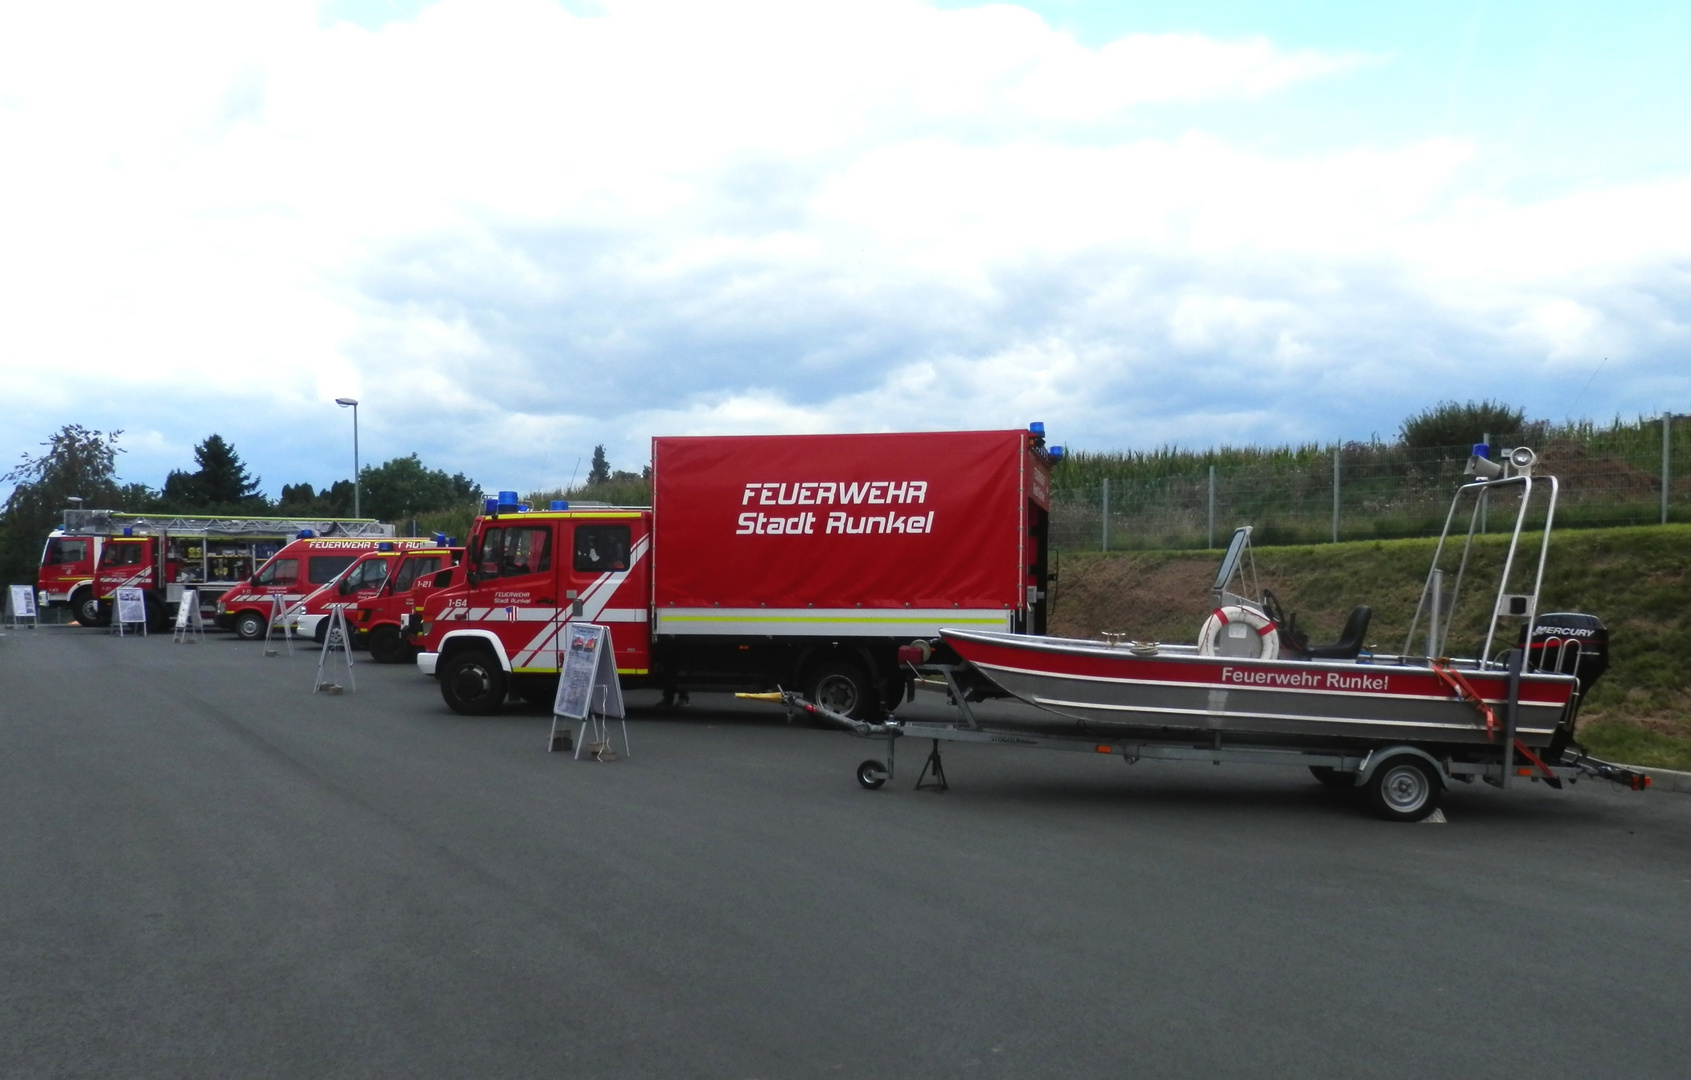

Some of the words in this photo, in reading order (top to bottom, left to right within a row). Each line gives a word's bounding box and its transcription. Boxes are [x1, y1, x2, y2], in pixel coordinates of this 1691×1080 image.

[742, 481, 928, 505] FEUERWEHR
[736, 511, 816, 535] Stadt
[825, 510, 935, 534] Runkel
[308, 541, 371, 549] FEUERWEHR
[417, 580, 431, 588] 1-21
[448, 598, 468, 607] 1-64
[1532, 625, 1595, 637] MERCURY
[1221, 667, 1321, 687] Feuerwehr
[1326, 673, 1389, 690] Runkel
